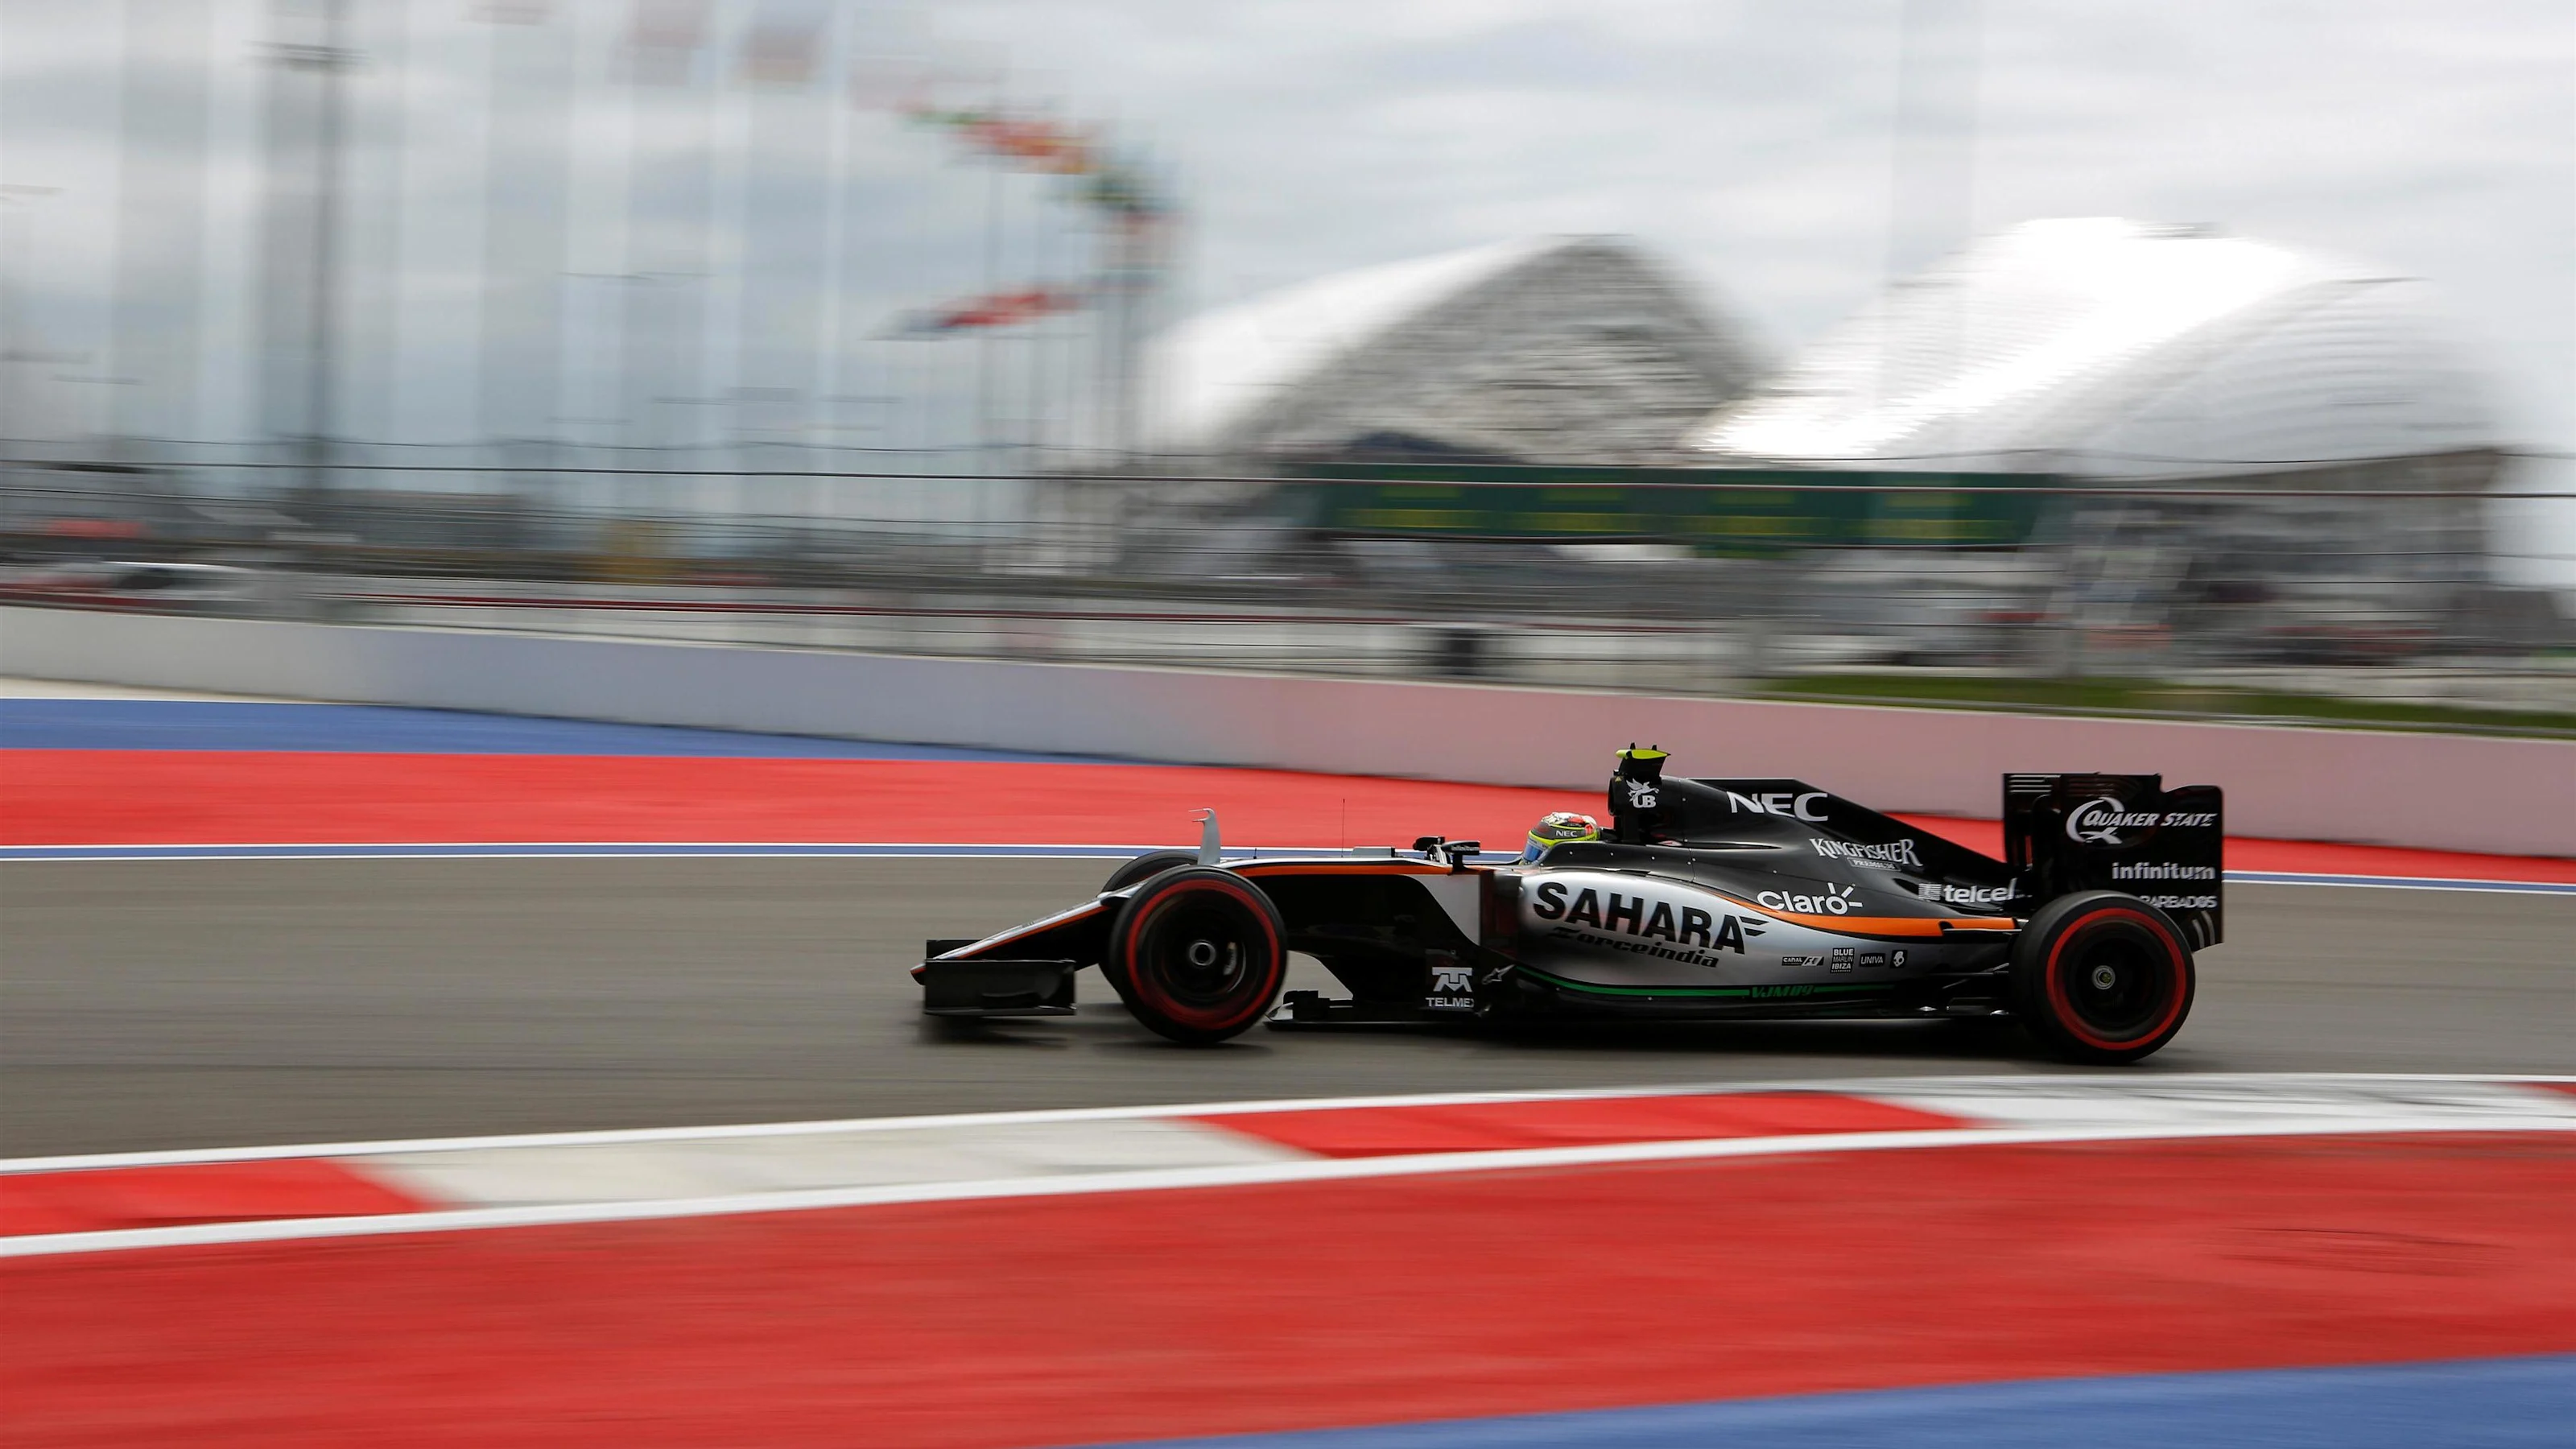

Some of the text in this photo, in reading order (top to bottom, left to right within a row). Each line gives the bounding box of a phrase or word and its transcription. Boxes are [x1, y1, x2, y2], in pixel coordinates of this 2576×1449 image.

[1632, 795, 1657, 809] UB
[1726, 791, 1829, 822] NEC
[2083, 810, 2219, 828] QUAKER STATE
[1809, 838, 1924, 867] KINGFISHER
[2112, 861, 2216, 880] infinitum
[1943, 877, 2018, 903] telcel
[1757, 890, 1850, 915] Claro
[1533, 881, 1746, 955] SAHARA
[1833, 948, 1854, 956] BLUE
[1860, 956, 1884, 965] UNIVA
